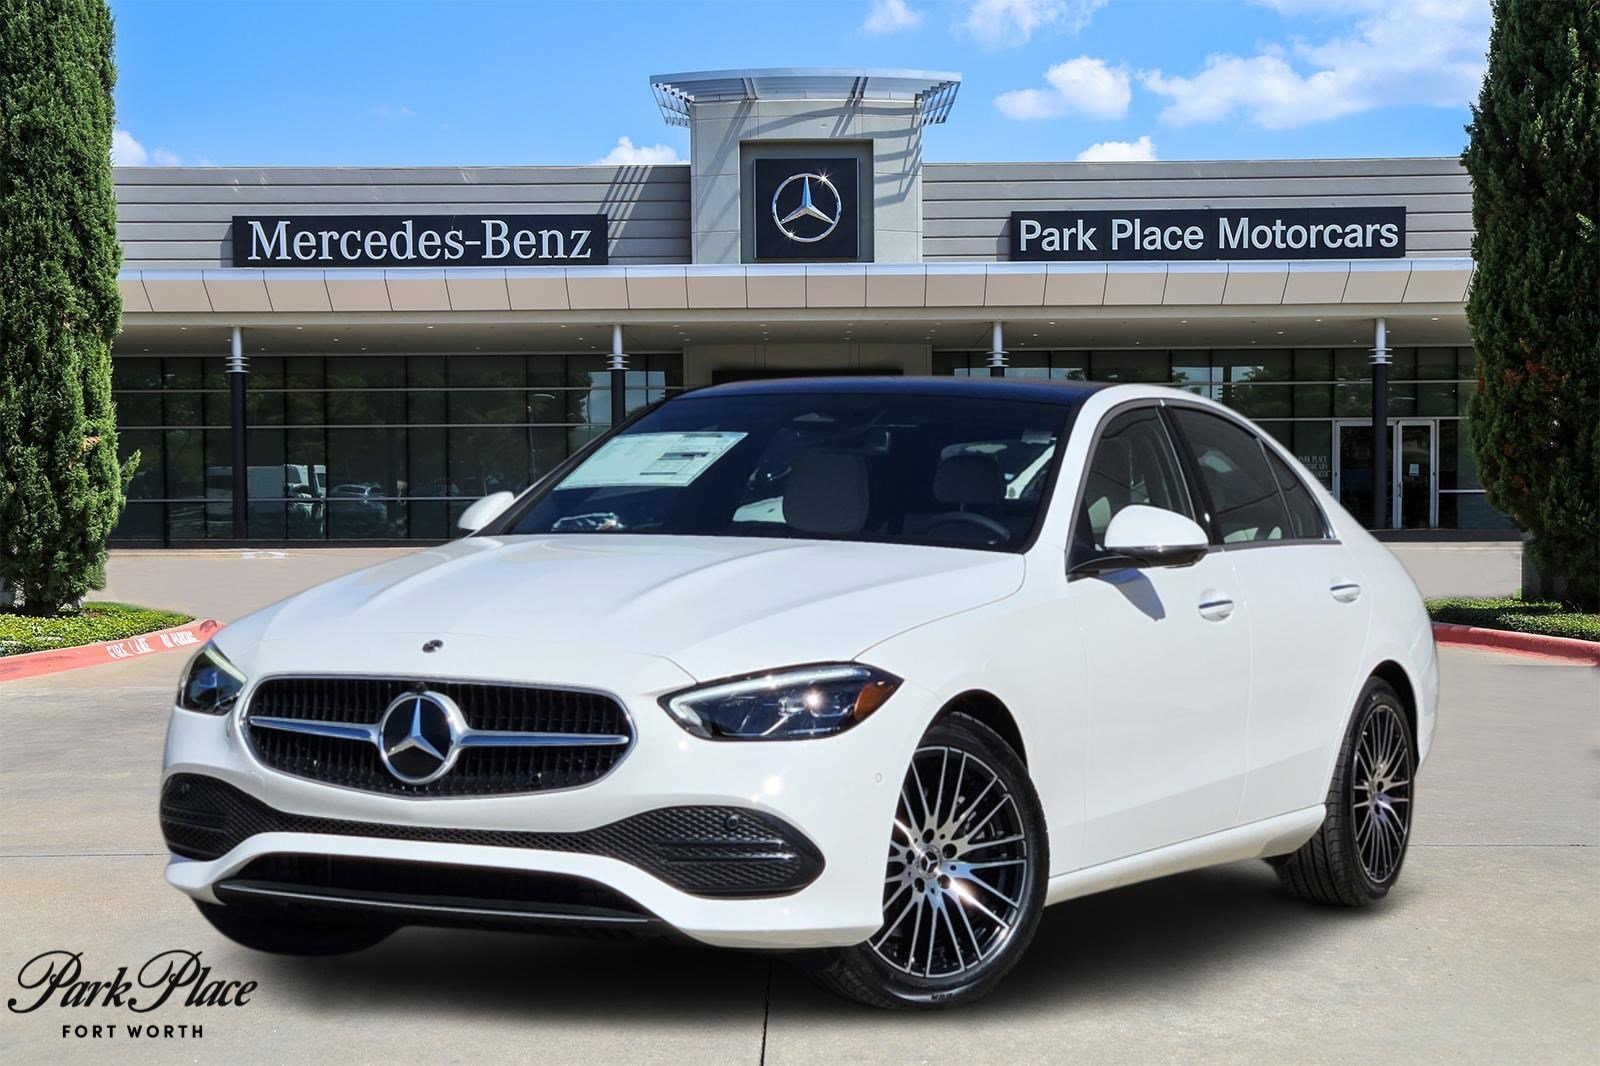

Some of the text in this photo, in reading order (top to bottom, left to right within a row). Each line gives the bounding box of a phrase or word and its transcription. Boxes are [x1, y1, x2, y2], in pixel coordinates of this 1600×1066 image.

[247, 219, 592, 260] Mercedes-Benz
[1019, 216, 1399, 251] Park Place Motorcars
